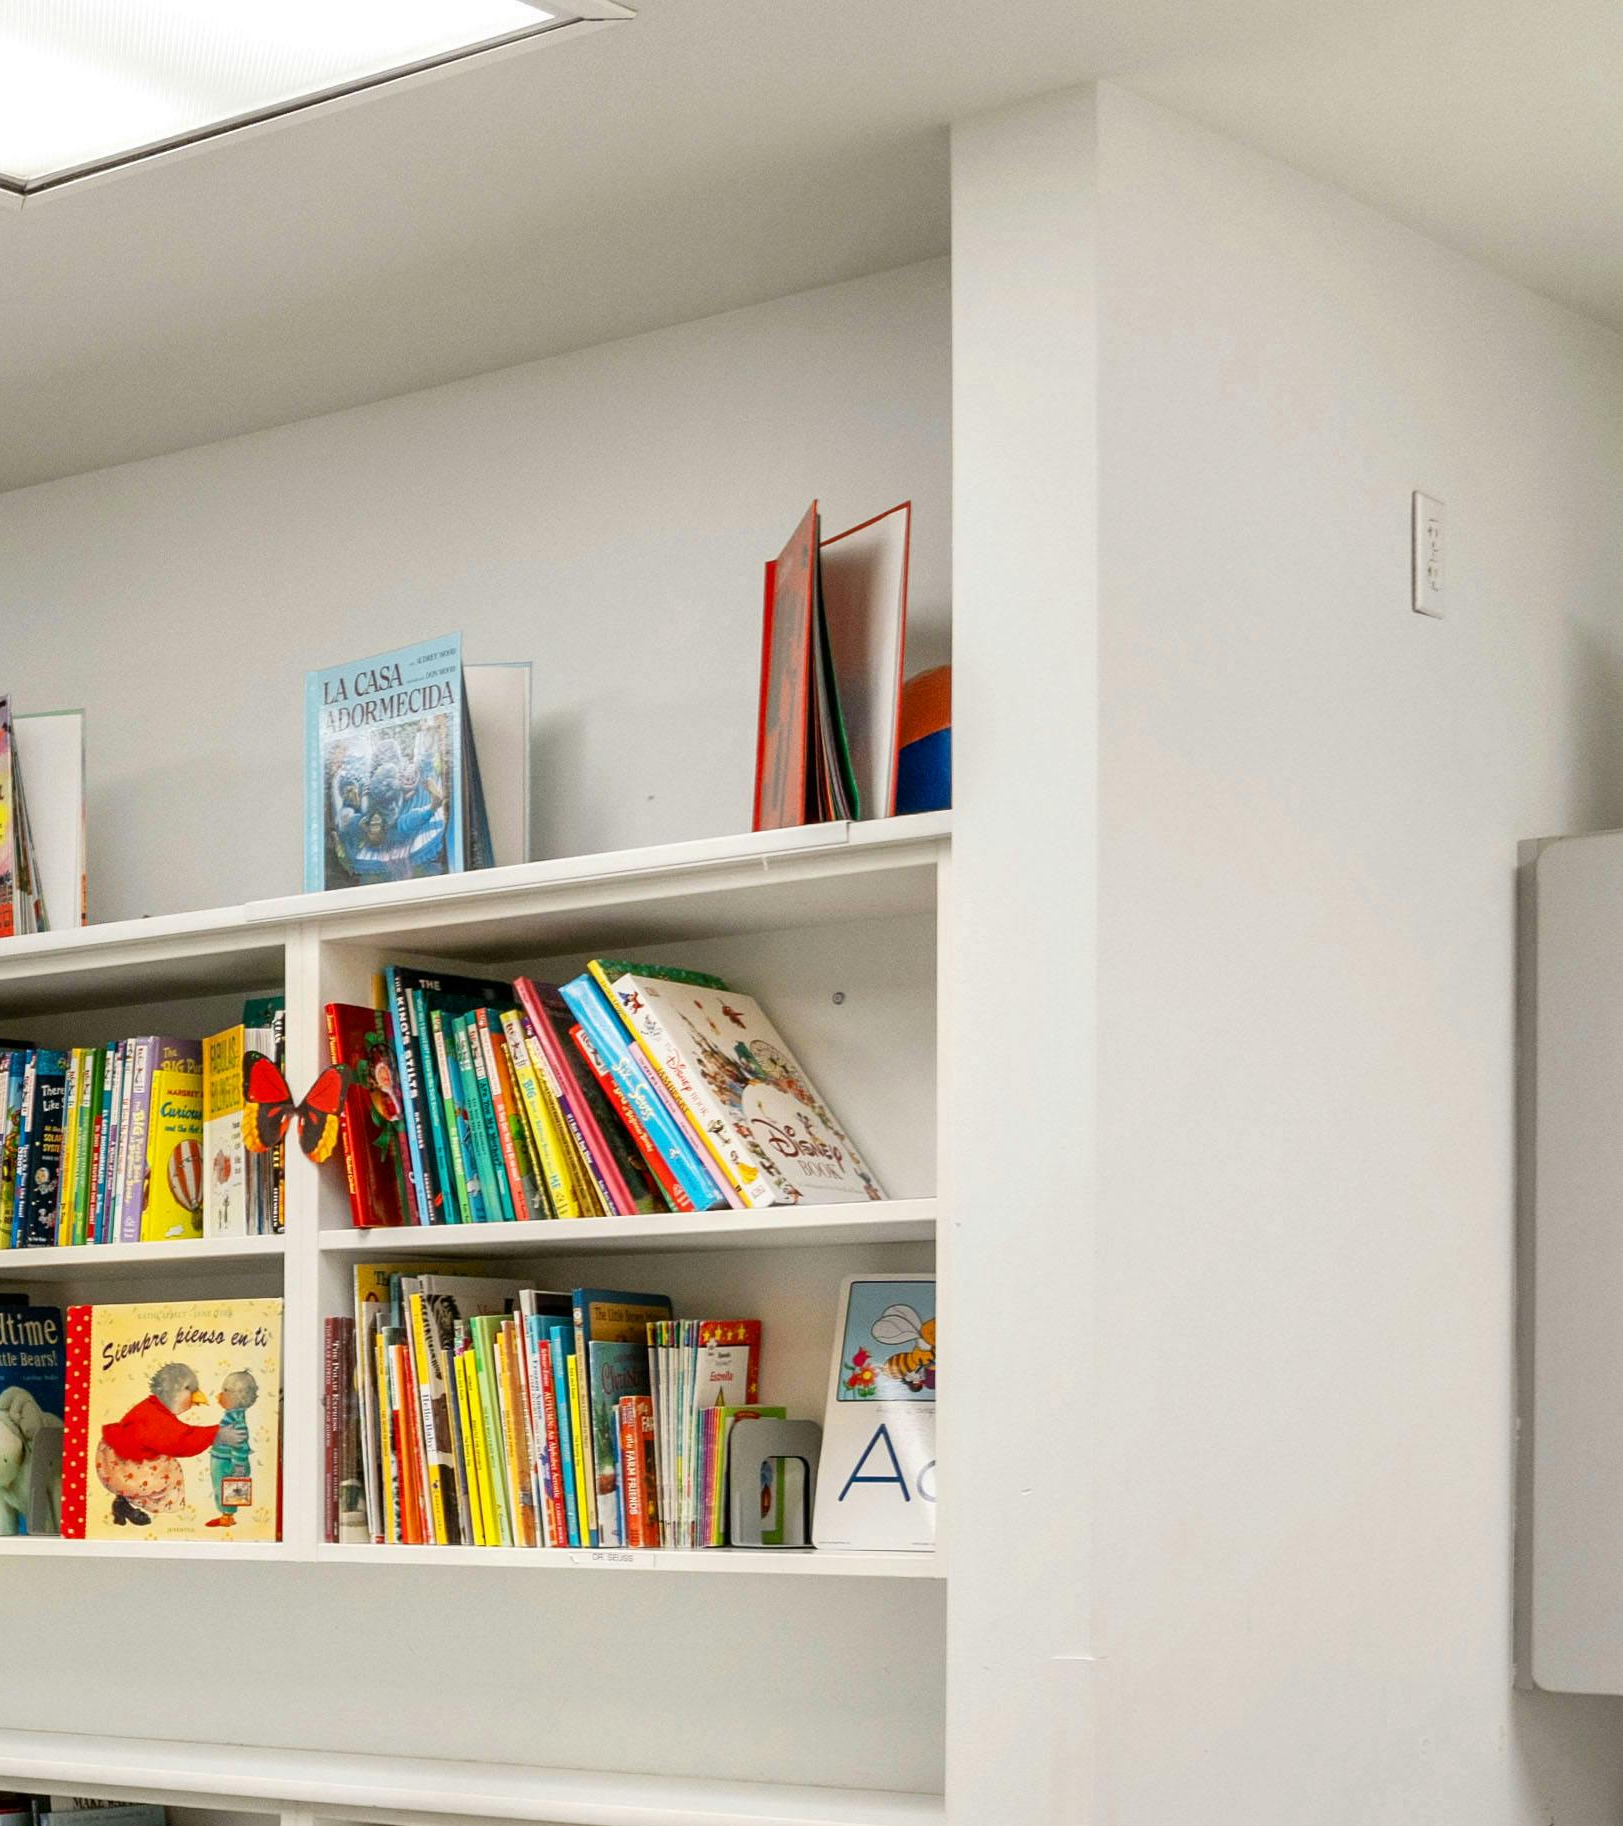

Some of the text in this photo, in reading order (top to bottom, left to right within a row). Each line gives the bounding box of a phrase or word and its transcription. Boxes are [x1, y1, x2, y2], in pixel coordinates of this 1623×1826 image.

[323, 663, 403, 706] LA CASA
[325, 681, 455, 734] ADORMECIDA
[395, 976, 403, 992] THE
[419, 978, 441, 991] THE
[395, 996, 411, 1045] KING'S
[162, 1046, 177, 1058] The
[167, 1088, 198, 1098] MARGRET
[403, 1049, 419, 1099] STILTS
[611, 1056, 658, 1123] Six Seuss
[42, 1099, 60, 1112] Like
[132, 1111, 144, 1135] BIG
[160, 1102, 203, 1120] Curious
[480, 1083, 502, 1167] Are You My Mother?
[522, 1079, 562, 1189] BIG ME
[755, 1120, 844, 1173] Disney
[15, 1146, 24, 1175] Snow
[799, 1160, 845, 1180] BOOK
[20, 1350, 58, 1367] Bears!
[102, 1325, 268, 1371] Siempre pienso en ti
[709, 1371, 733, 1382] Estrella
[421, 1395, 437, 1452] Hello Baby!
[543, 1392, 562, 1498] AUTUMN: An Alphabet Acrostic
[626, 1451, 638, 1515] FARM FRIENDS
